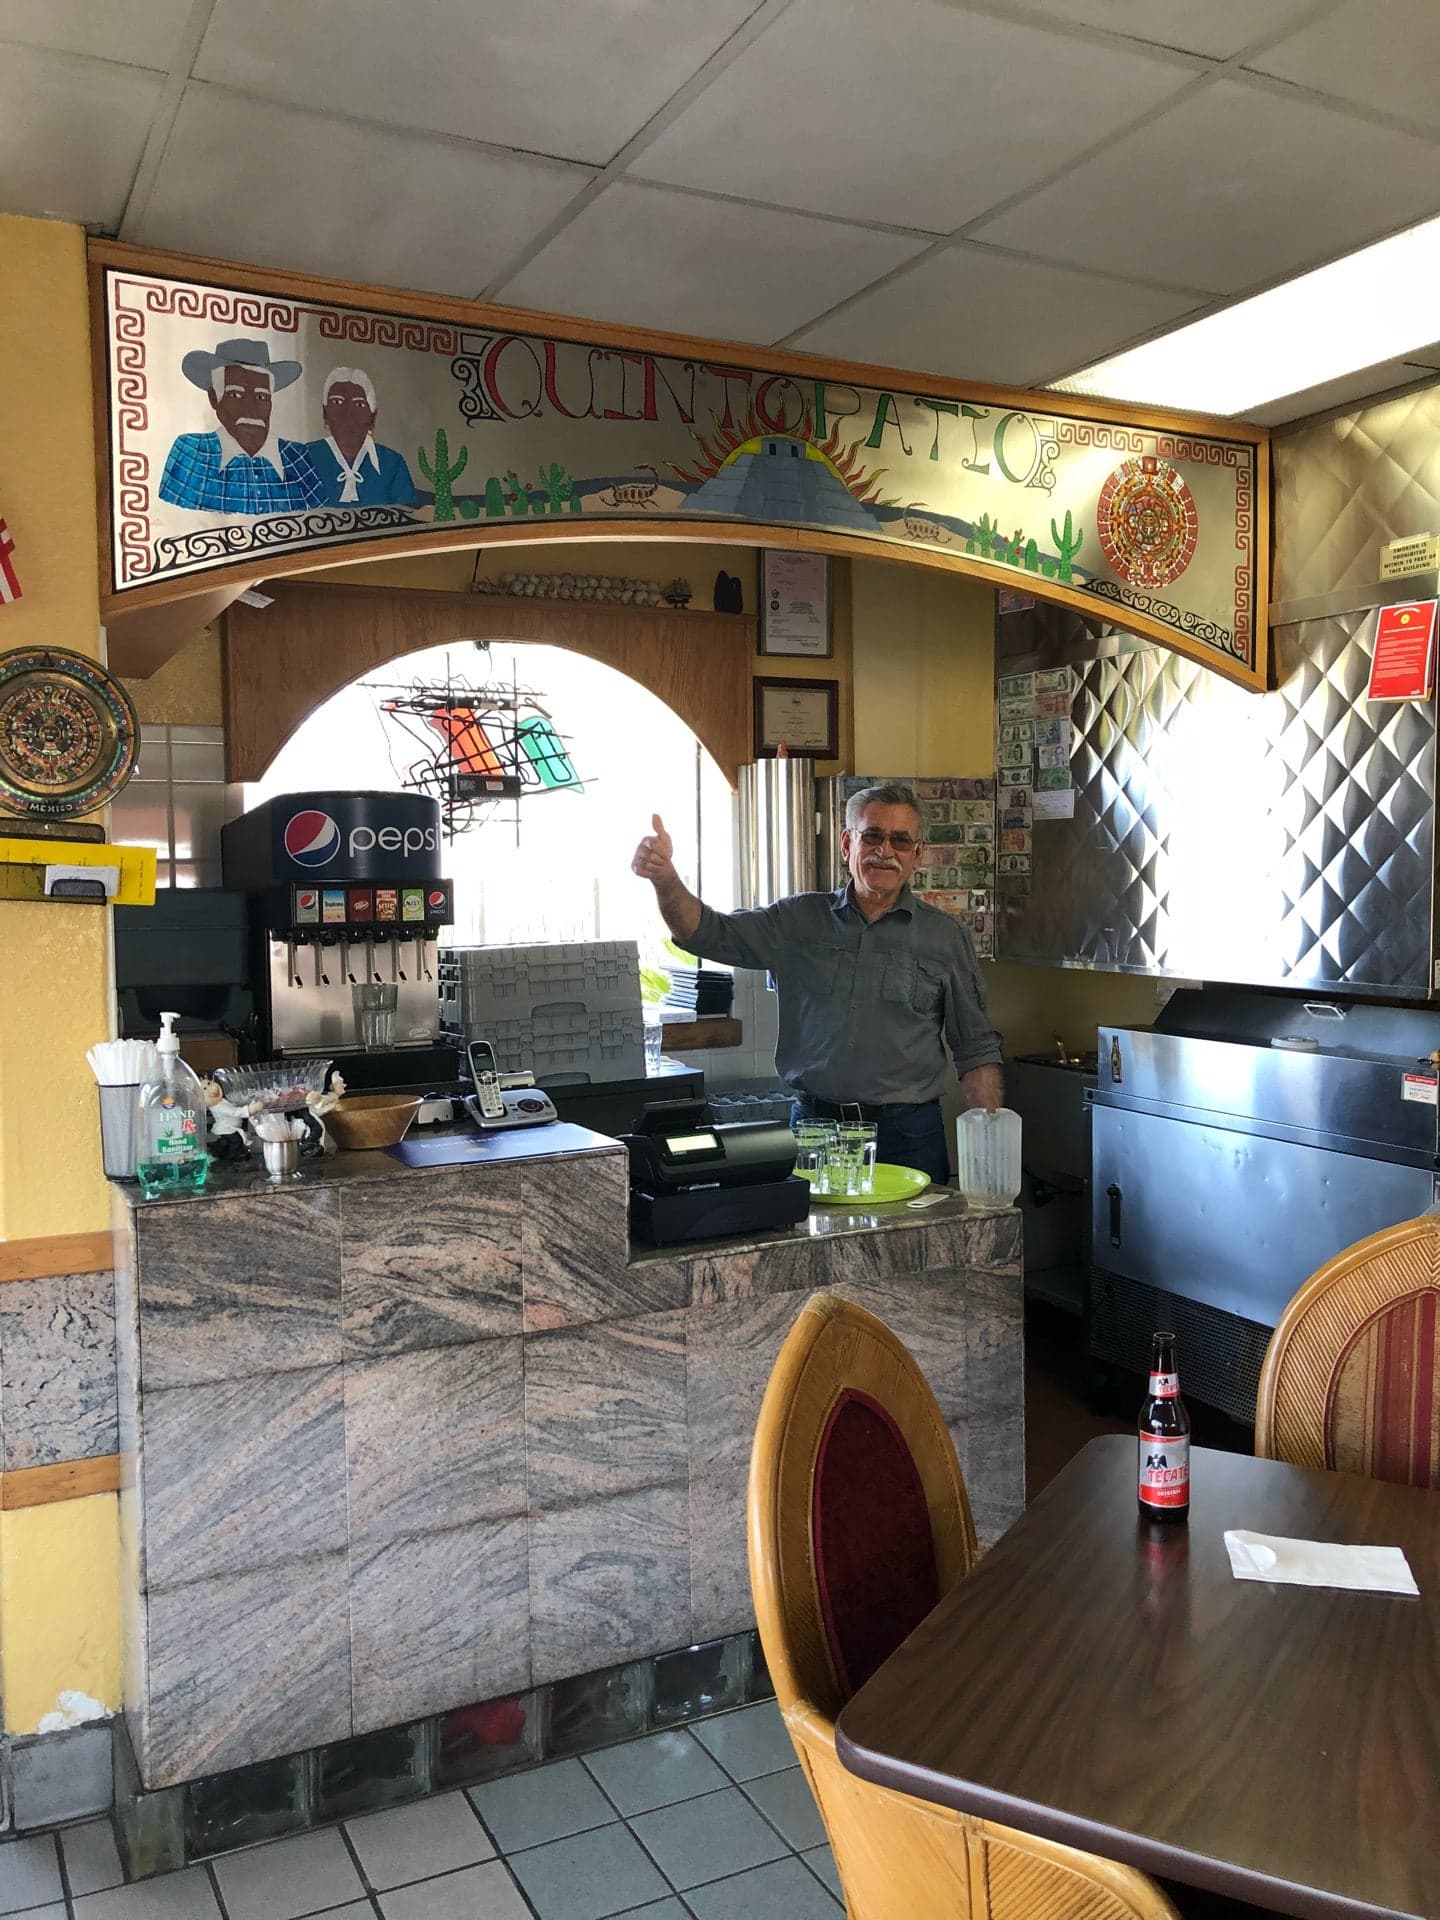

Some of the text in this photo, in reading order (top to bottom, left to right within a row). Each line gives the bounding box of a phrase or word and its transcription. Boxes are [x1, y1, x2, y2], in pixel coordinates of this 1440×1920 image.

[484, 334, 1038, 484] QUINTO PATIO
[1393, 544, 1419, 553] SMOKING
[1393, 549, 1426, 559] PROHIBITED
[1384, 560, 1403, 568] WITHIN
[1403, 562, 1430, 571] BUILDING
[29, 803, 73, 812] MEXICO
[349, 821, 441, 858] pepsi
[160, 1109, 195, 1122] HAND
[168, 1138, 188, 1146] Hand
[162, 1145, 194, 1153] Sanitizer
